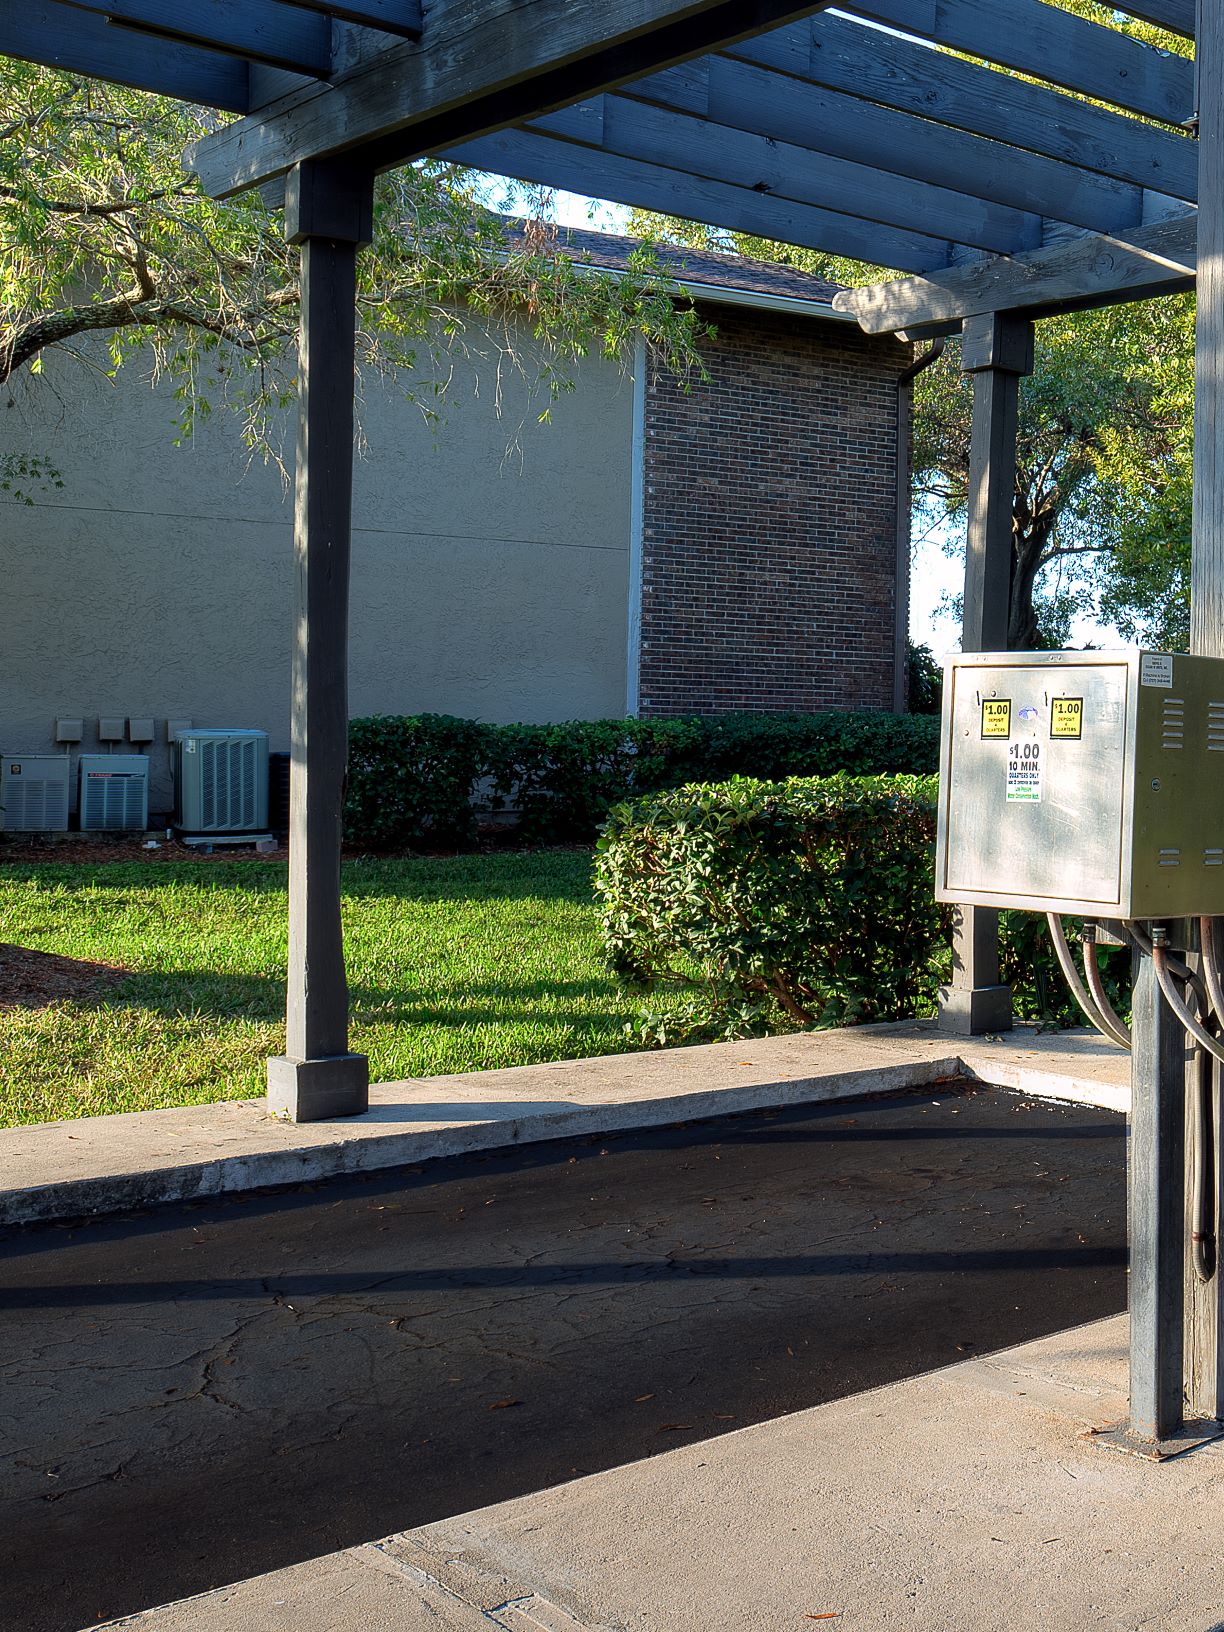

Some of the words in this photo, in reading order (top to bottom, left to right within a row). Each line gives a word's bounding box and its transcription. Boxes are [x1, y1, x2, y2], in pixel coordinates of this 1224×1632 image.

[985, 704, 1008, 715] $1.00
[1055, 703, 1080, 714] $1.00
[1009, 743, 1040, 759] $1.00
[1009, 761, 1018, 771] 10
[1020, 761, 1040, 771] MIN.
